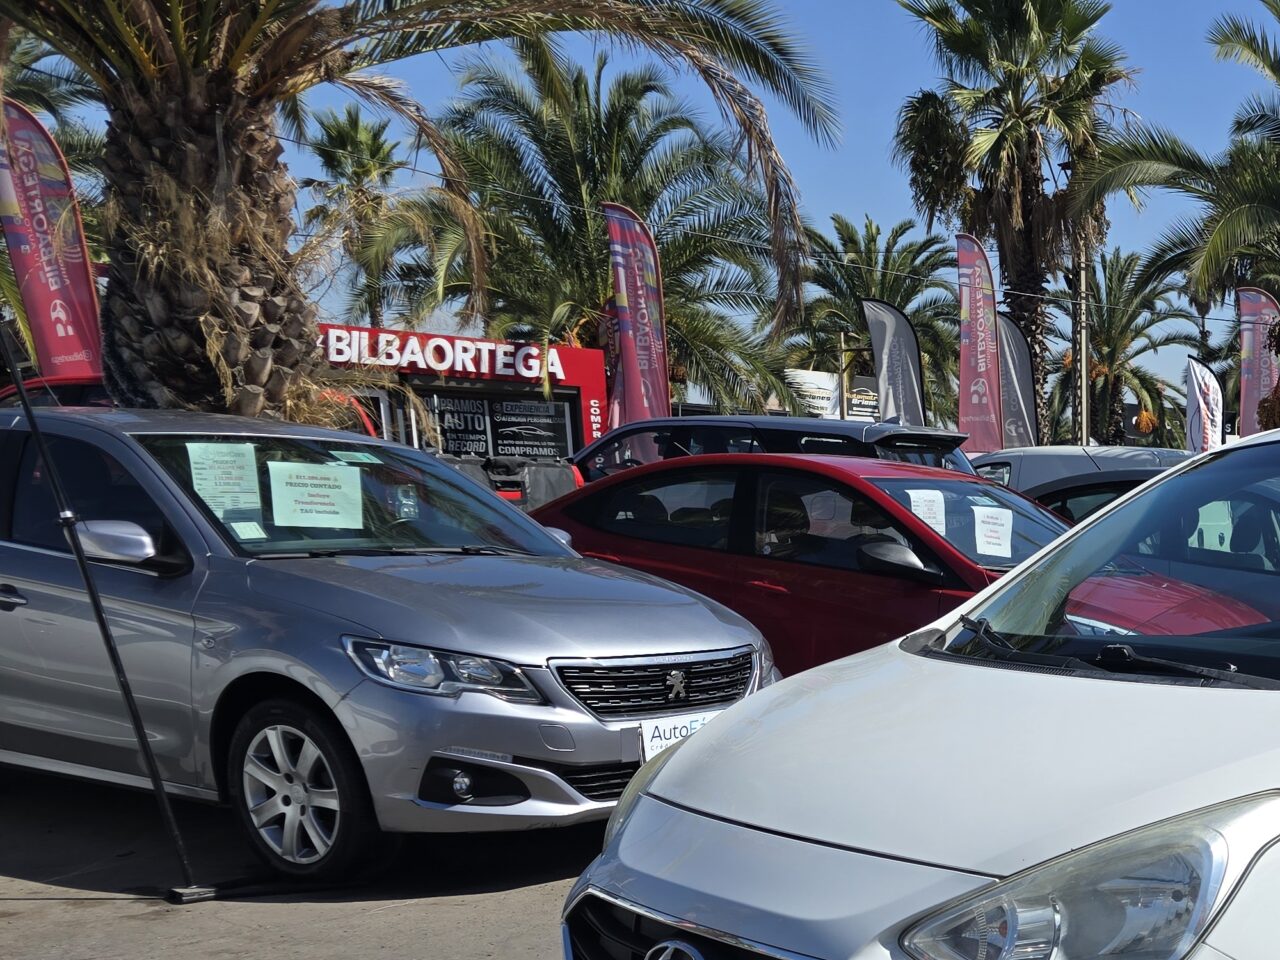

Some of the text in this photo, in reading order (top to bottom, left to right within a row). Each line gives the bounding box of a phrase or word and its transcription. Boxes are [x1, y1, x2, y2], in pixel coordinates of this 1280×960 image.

[328, 328, 566, 381] BILBAORTEGA
[423, 397, 484, 413] OMPRAMOS
[505, 403, 550, 414] EXPERIENCIA
[444, 412, 485, 431] AUTO
[448, 440, 486, 453] RECORD
[498, 446, 560, 456] COMPRAMOS
